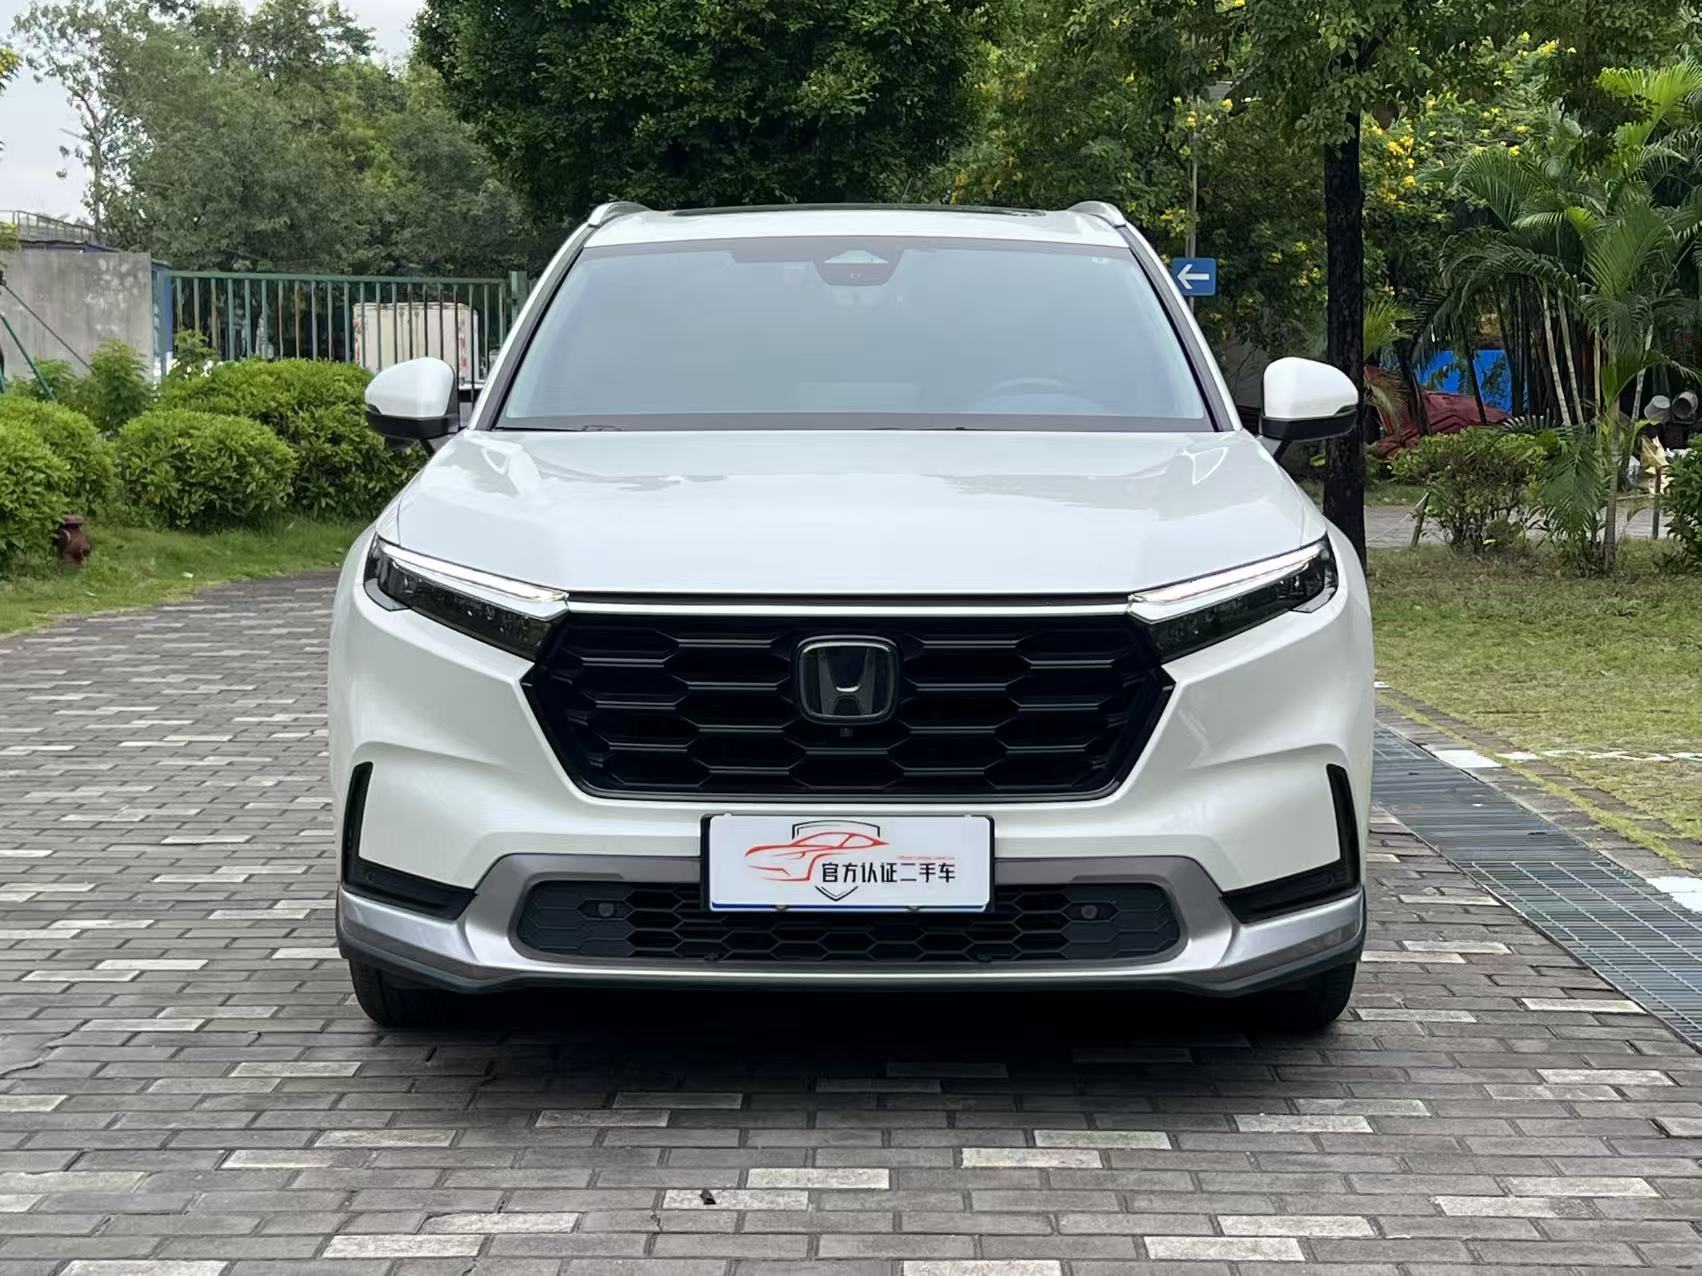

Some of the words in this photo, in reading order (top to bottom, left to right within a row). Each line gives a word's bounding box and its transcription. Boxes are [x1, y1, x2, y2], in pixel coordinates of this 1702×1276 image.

[821, 862, 956, 883] 官方认证二手车
